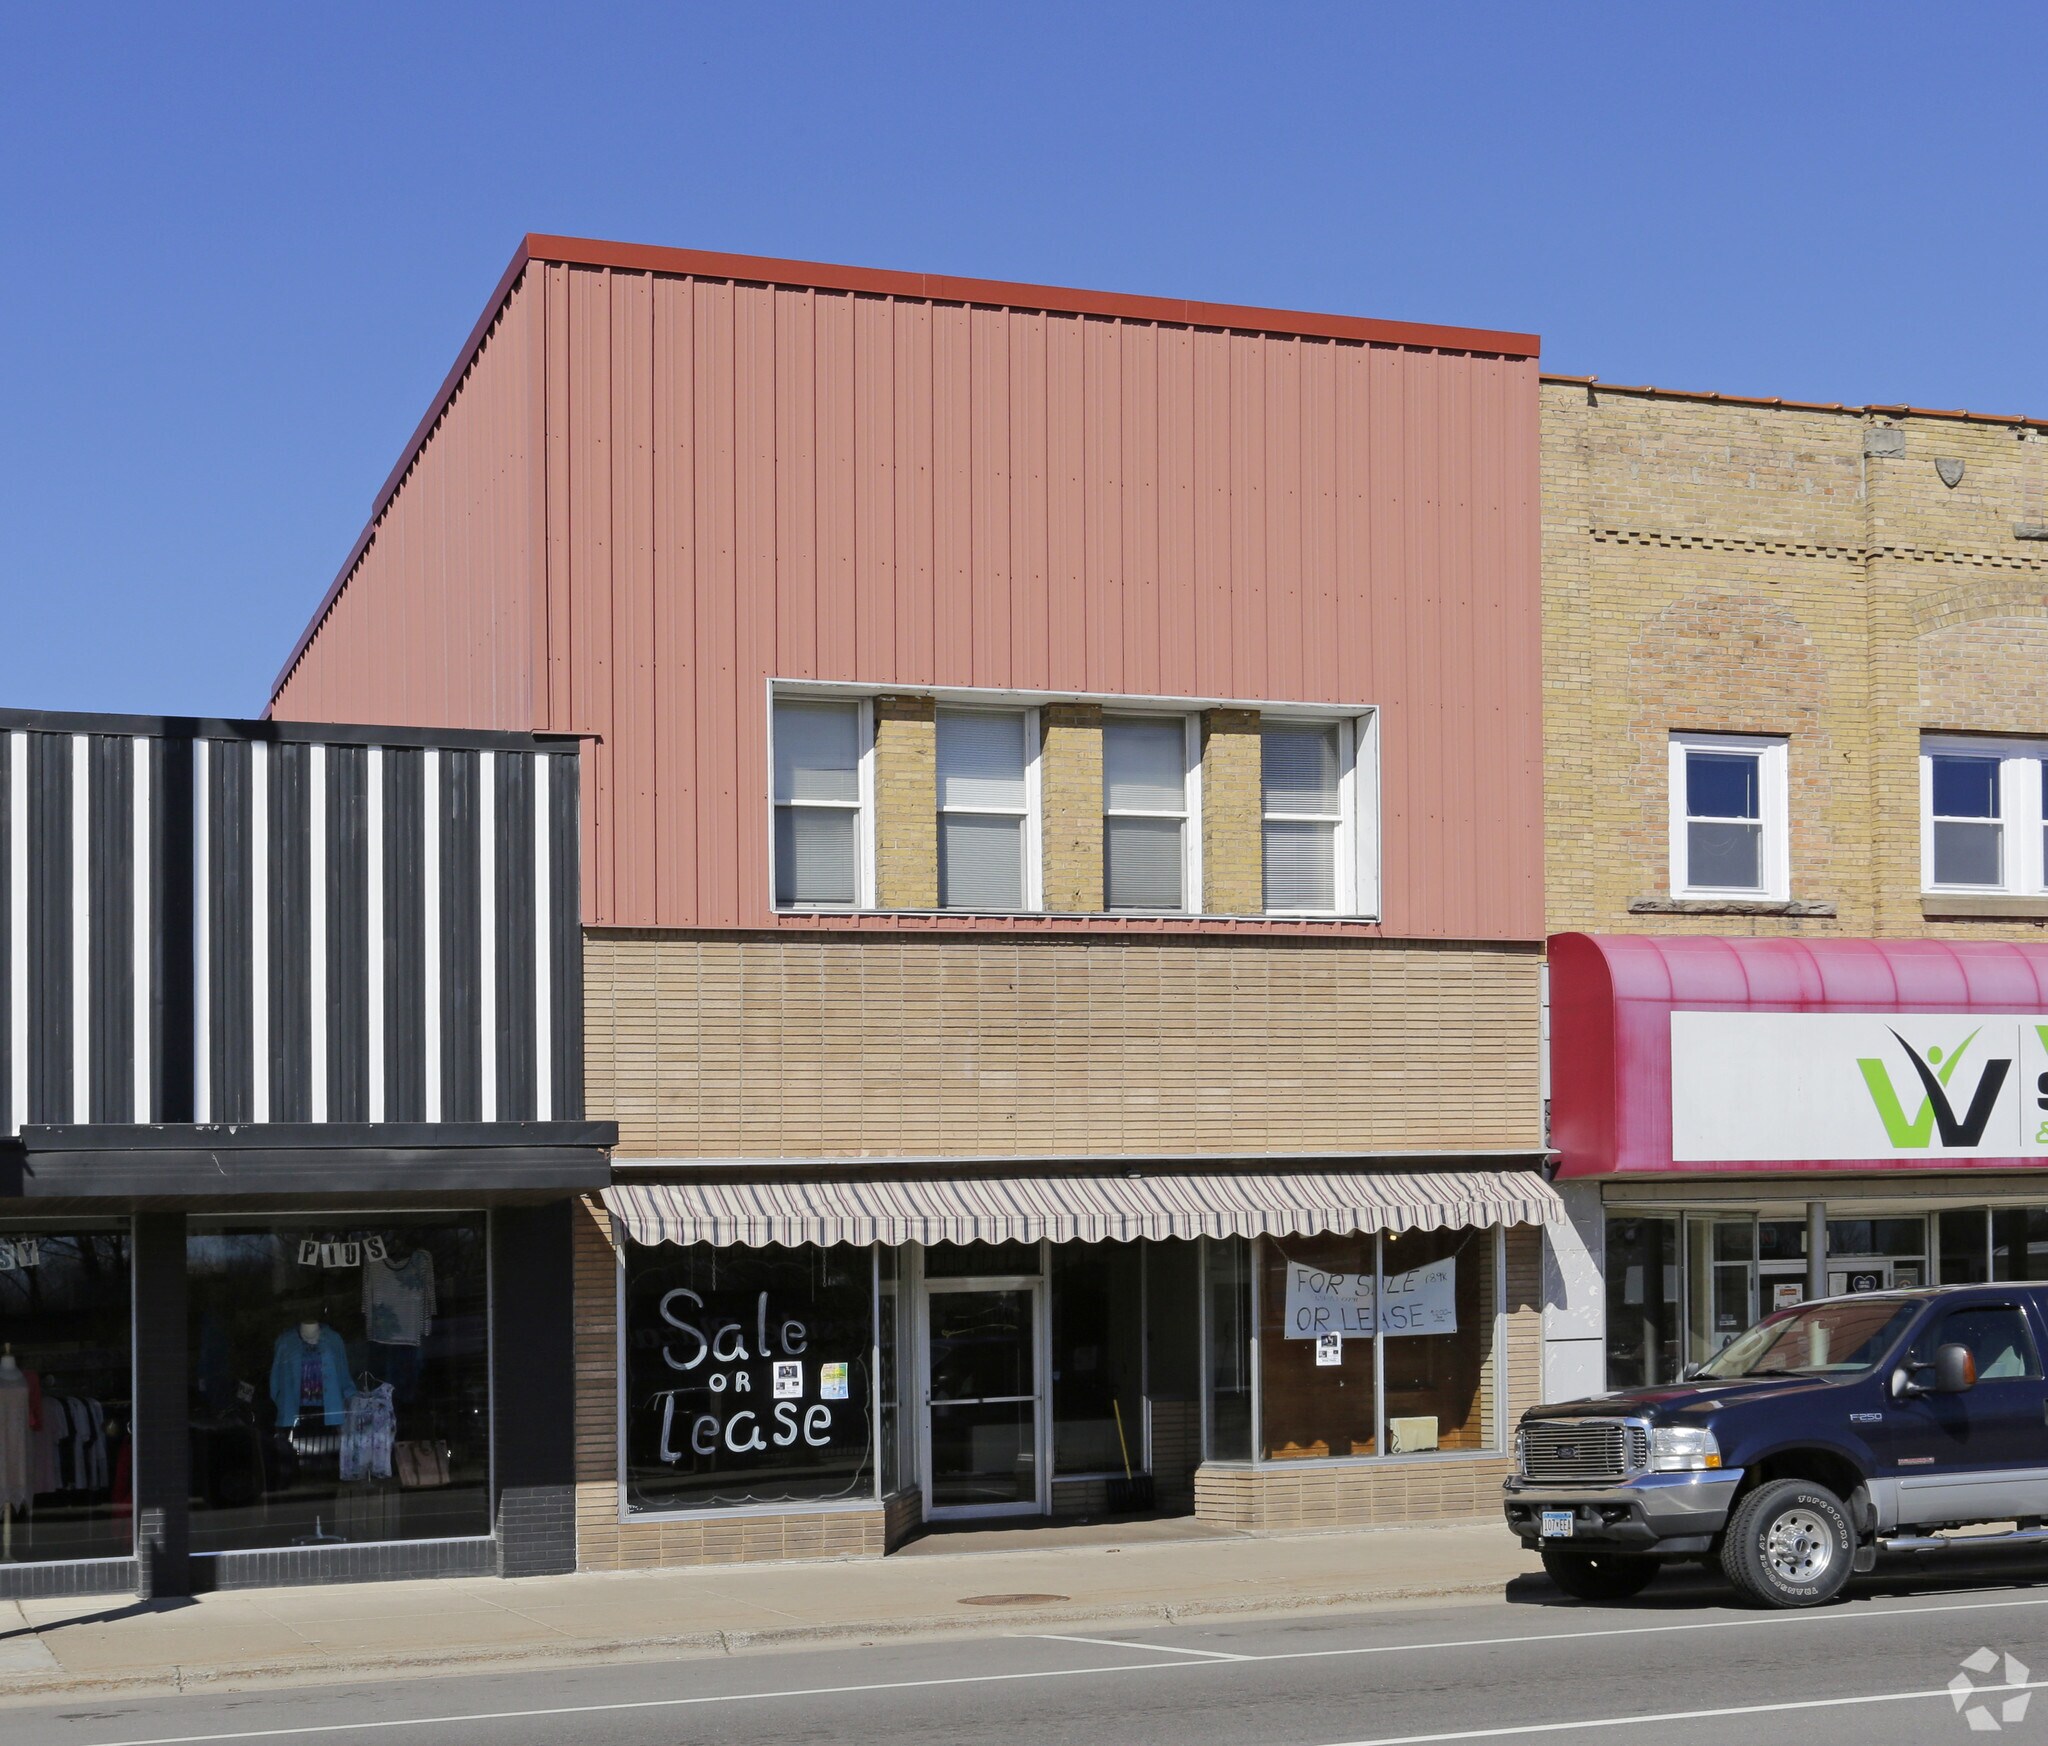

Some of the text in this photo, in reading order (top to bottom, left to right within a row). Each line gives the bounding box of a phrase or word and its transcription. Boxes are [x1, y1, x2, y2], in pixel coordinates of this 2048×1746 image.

[1297, 1269, 1344, 1294] FOR
[660, 1288, 807, 1370] Sale
[1297, 1307, 1330, 1331] OR
[708, 1371, 750, 1392] OR
[660, 1394, 832, 1462] Lease
